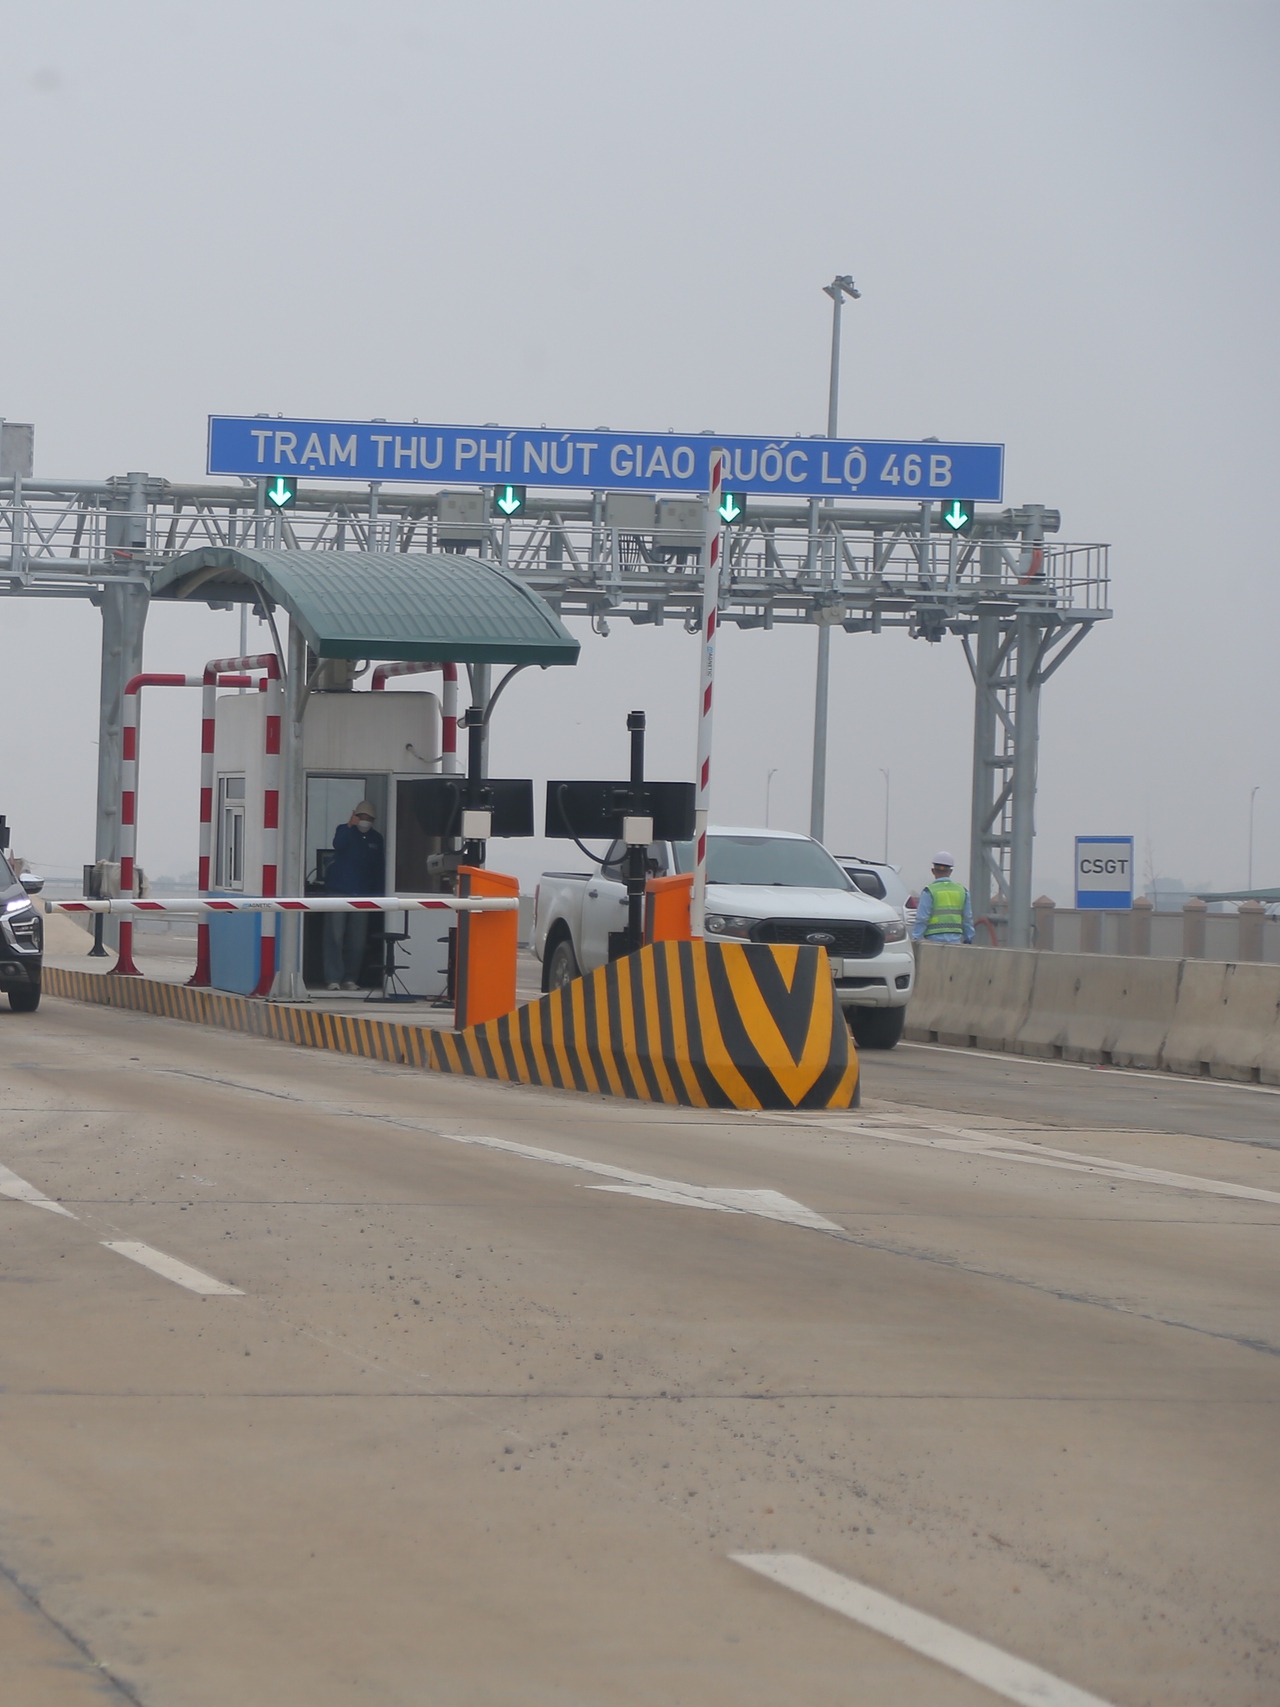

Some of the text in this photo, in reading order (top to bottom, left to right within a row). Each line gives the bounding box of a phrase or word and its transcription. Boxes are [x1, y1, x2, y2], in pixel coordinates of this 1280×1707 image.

[251, 430, 357, 471] TRẠM
[370, 435, 443, 470] THU
[455, 432, 517, 472] PHÍ
[524, 434, 598, 476] NÚT
[610, 444, 695, 480] GIAO
[822, 446, 867, 491] LỘ
[1080, 859, 1129, 874] CSGT
